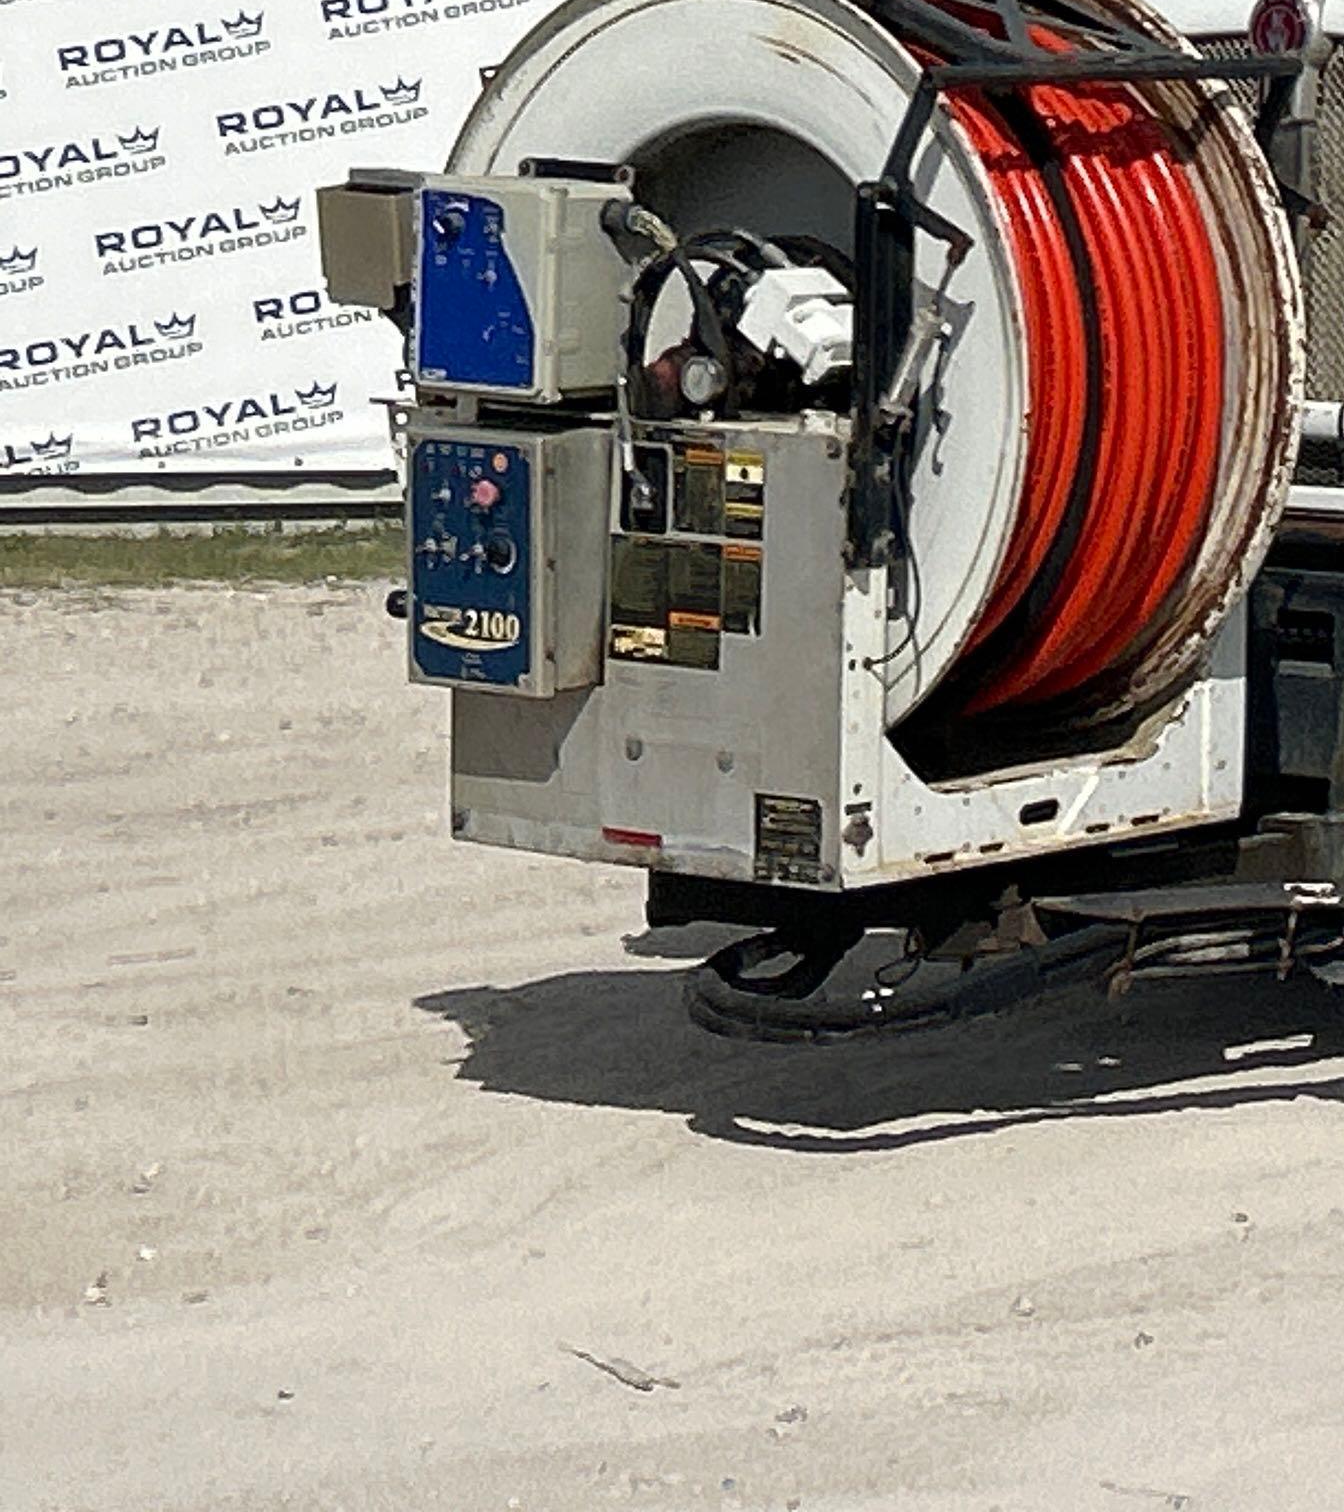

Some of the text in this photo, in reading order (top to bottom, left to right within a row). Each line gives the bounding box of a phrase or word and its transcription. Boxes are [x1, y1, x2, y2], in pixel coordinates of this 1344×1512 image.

[57, 22, 223, 71] ROYAL
[328, 8, 439, 40] AUCTION
[65, 40, 271, 89] AUCTION GROUP
[217, 89, 381, 136] ROYAL
[224, 106, 429, 156] AUCTION GROUP
[0, 138, 119, 179] OYAL
[0, 156, 166, 200] CTION GROUP
[95, 208, 259, 257] ROYAL
[102, 225, 307, 276] AUCTION GROUP
[0, 324, 155, 370] ROYAL
[261, 309, 372, 341] AUCTION
[0, 342, 203, 389] AUCTION GROUP
[132, 392, 295, 442] ROYAL
[138, 409, 344, 459] AUCTION GROUP
[464, 609, 520, 641] 2100
